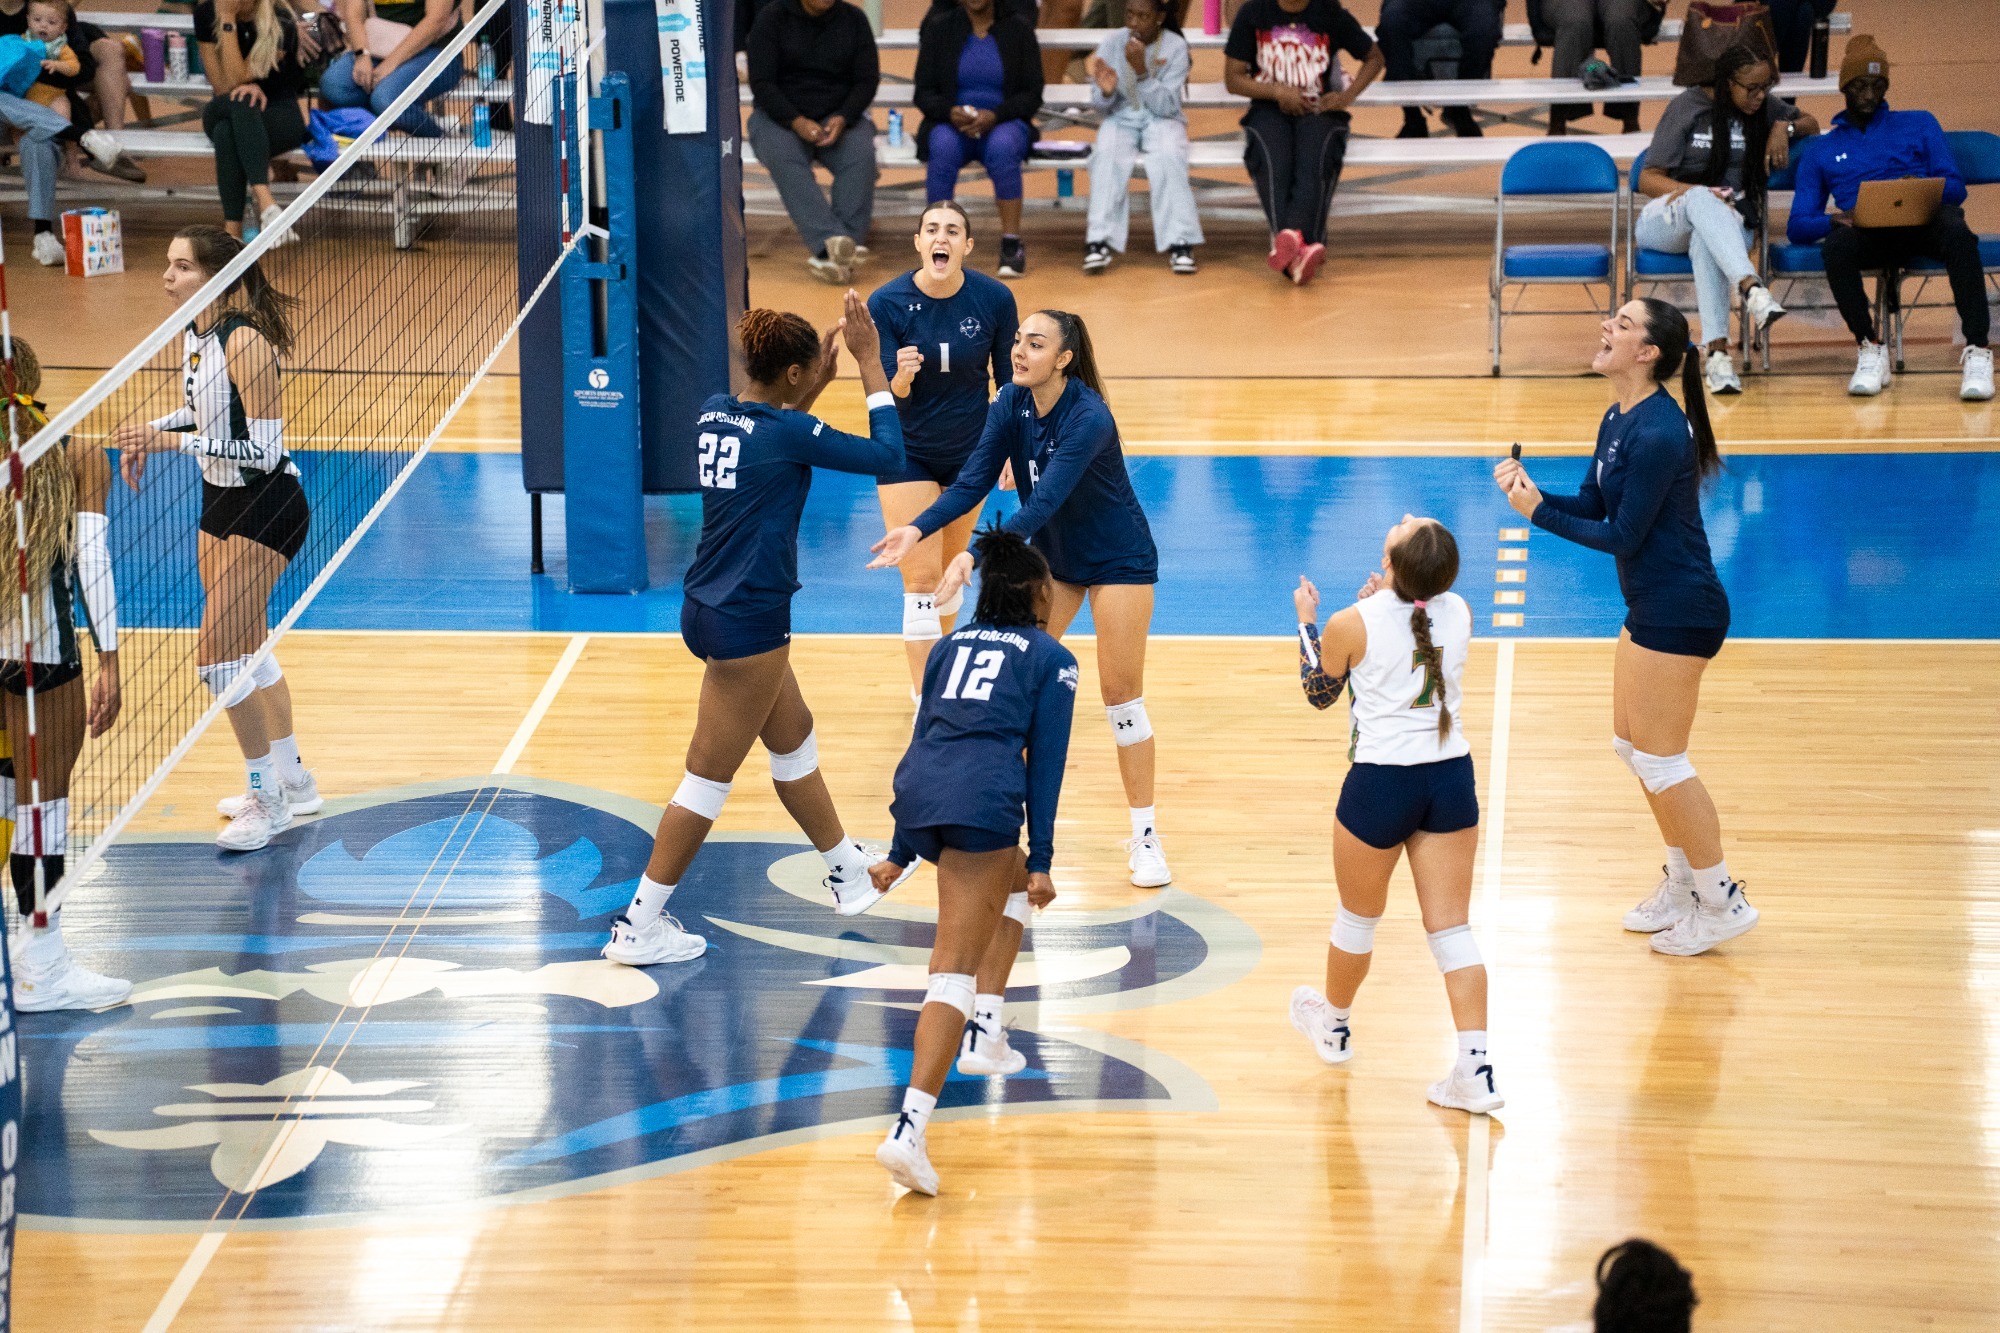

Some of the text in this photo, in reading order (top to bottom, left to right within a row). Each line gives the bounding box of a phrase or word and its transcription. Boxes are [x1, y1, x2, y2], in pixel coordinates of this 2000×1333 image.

[543, 0, 552, 43] WERADE
[669, 39, 685, 104] POWERADE
[939, 343, 950, 372] 1
[206, 438, 265, 460] LIONS
[698, 432, 740, 489] 22
[941, 645, 1005, 701] 12
[1409, 646, 1444, 709] 7
